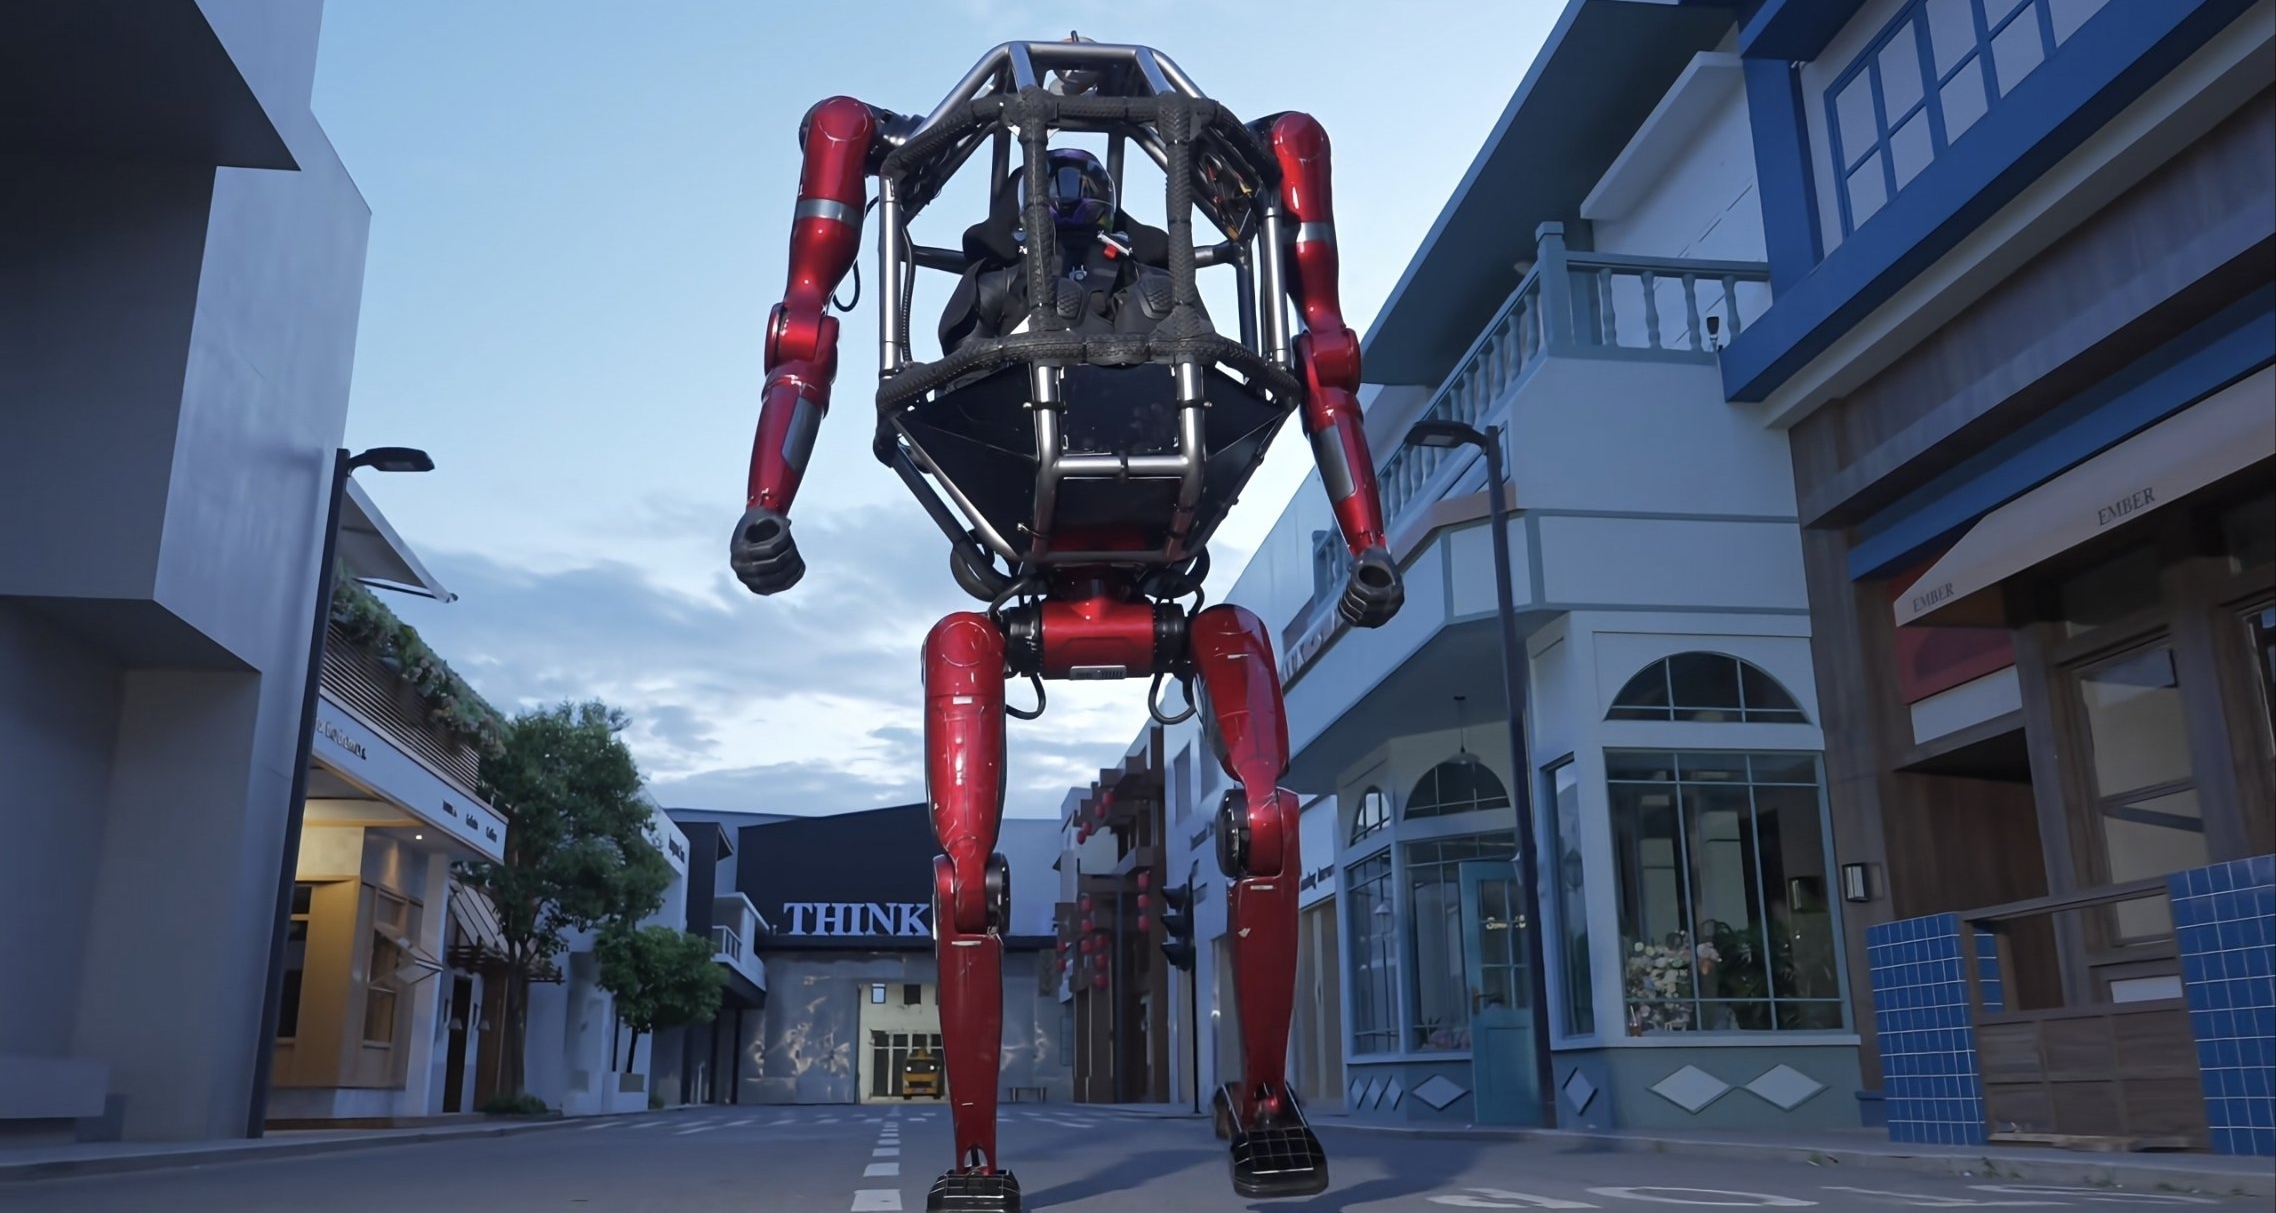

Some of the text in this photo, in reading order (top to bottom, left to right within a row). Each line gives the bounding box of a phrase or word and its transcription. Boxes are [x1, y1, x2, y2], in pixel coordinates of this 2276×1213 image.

[2098, 487, 2155, 526] EMBER
[1913, 583, 1954, 612] EMBER
[783, 902, 930, 936] THINK
